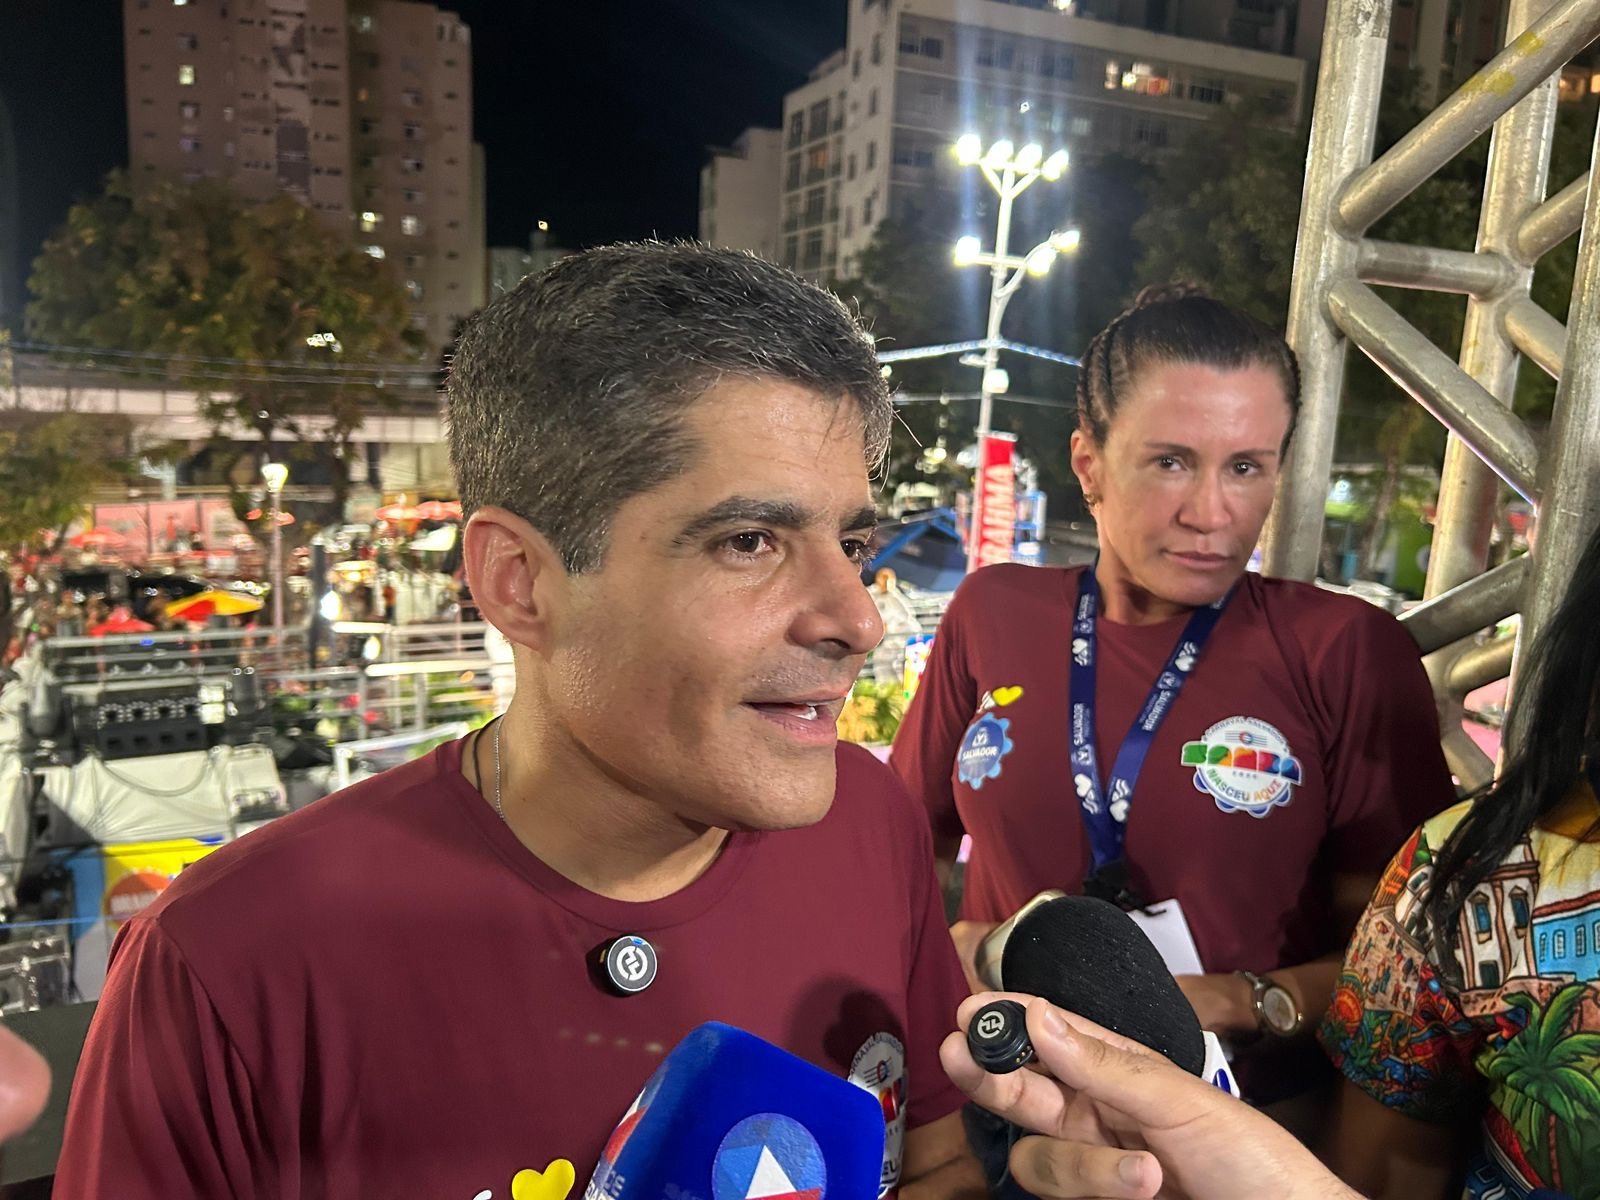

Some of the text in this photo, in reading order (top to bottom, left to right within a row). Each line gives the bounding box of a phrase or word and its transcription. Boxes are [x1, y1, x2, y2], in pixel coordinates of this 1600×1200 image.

[980, 464, 1014, 568] RAHMA
[1206, 768, 1281, 801] NASCEU AQUI
